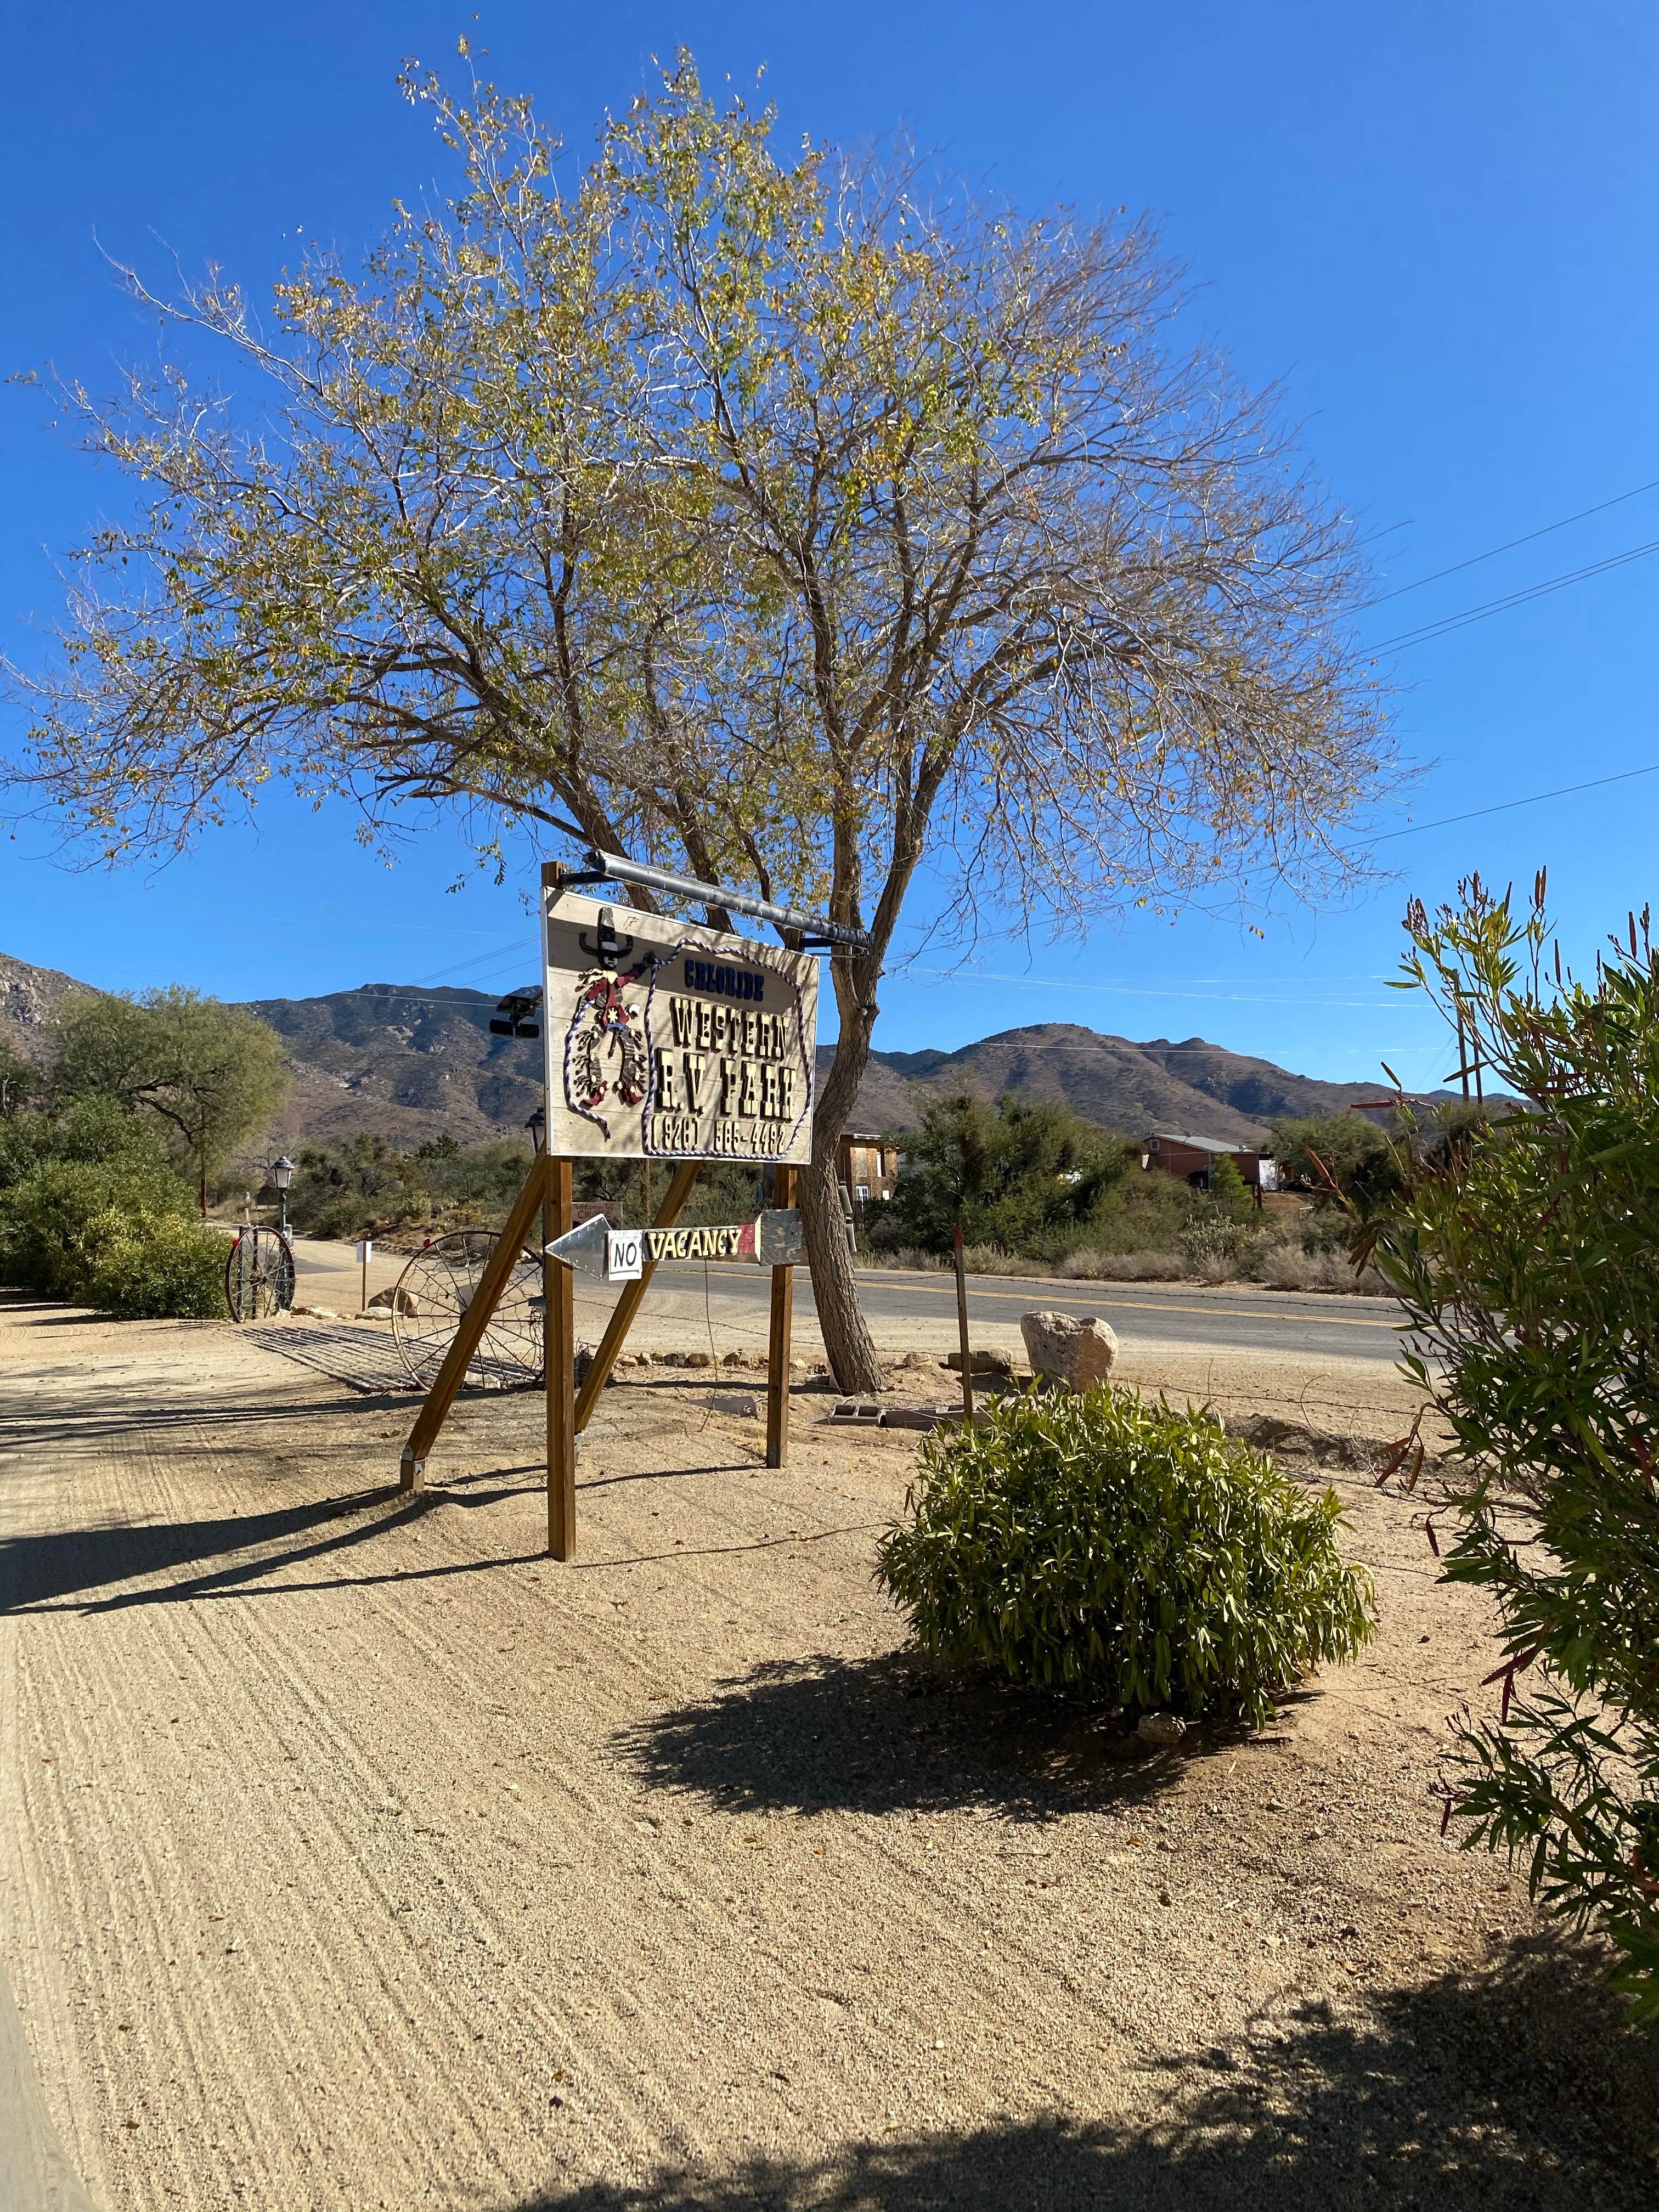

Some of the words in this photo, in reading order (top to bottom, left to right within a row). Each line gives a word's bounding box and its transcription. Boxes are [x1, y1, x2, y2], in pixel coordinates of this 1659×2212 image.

[685, 959, 764, 1002] CHLORIDE
[670, 996, 789, 1062] WESTERN
[656, 1048, 707, 1116] R.V.
[720, 1058, 796, 1123] PARK
[651, 1115, 699, 1150] (928)
[714, 1120, 786, 1155] 585-4492
[614, 1242, 637, 1267] NO
[648, 1228, 742, 1261] VACANCY
